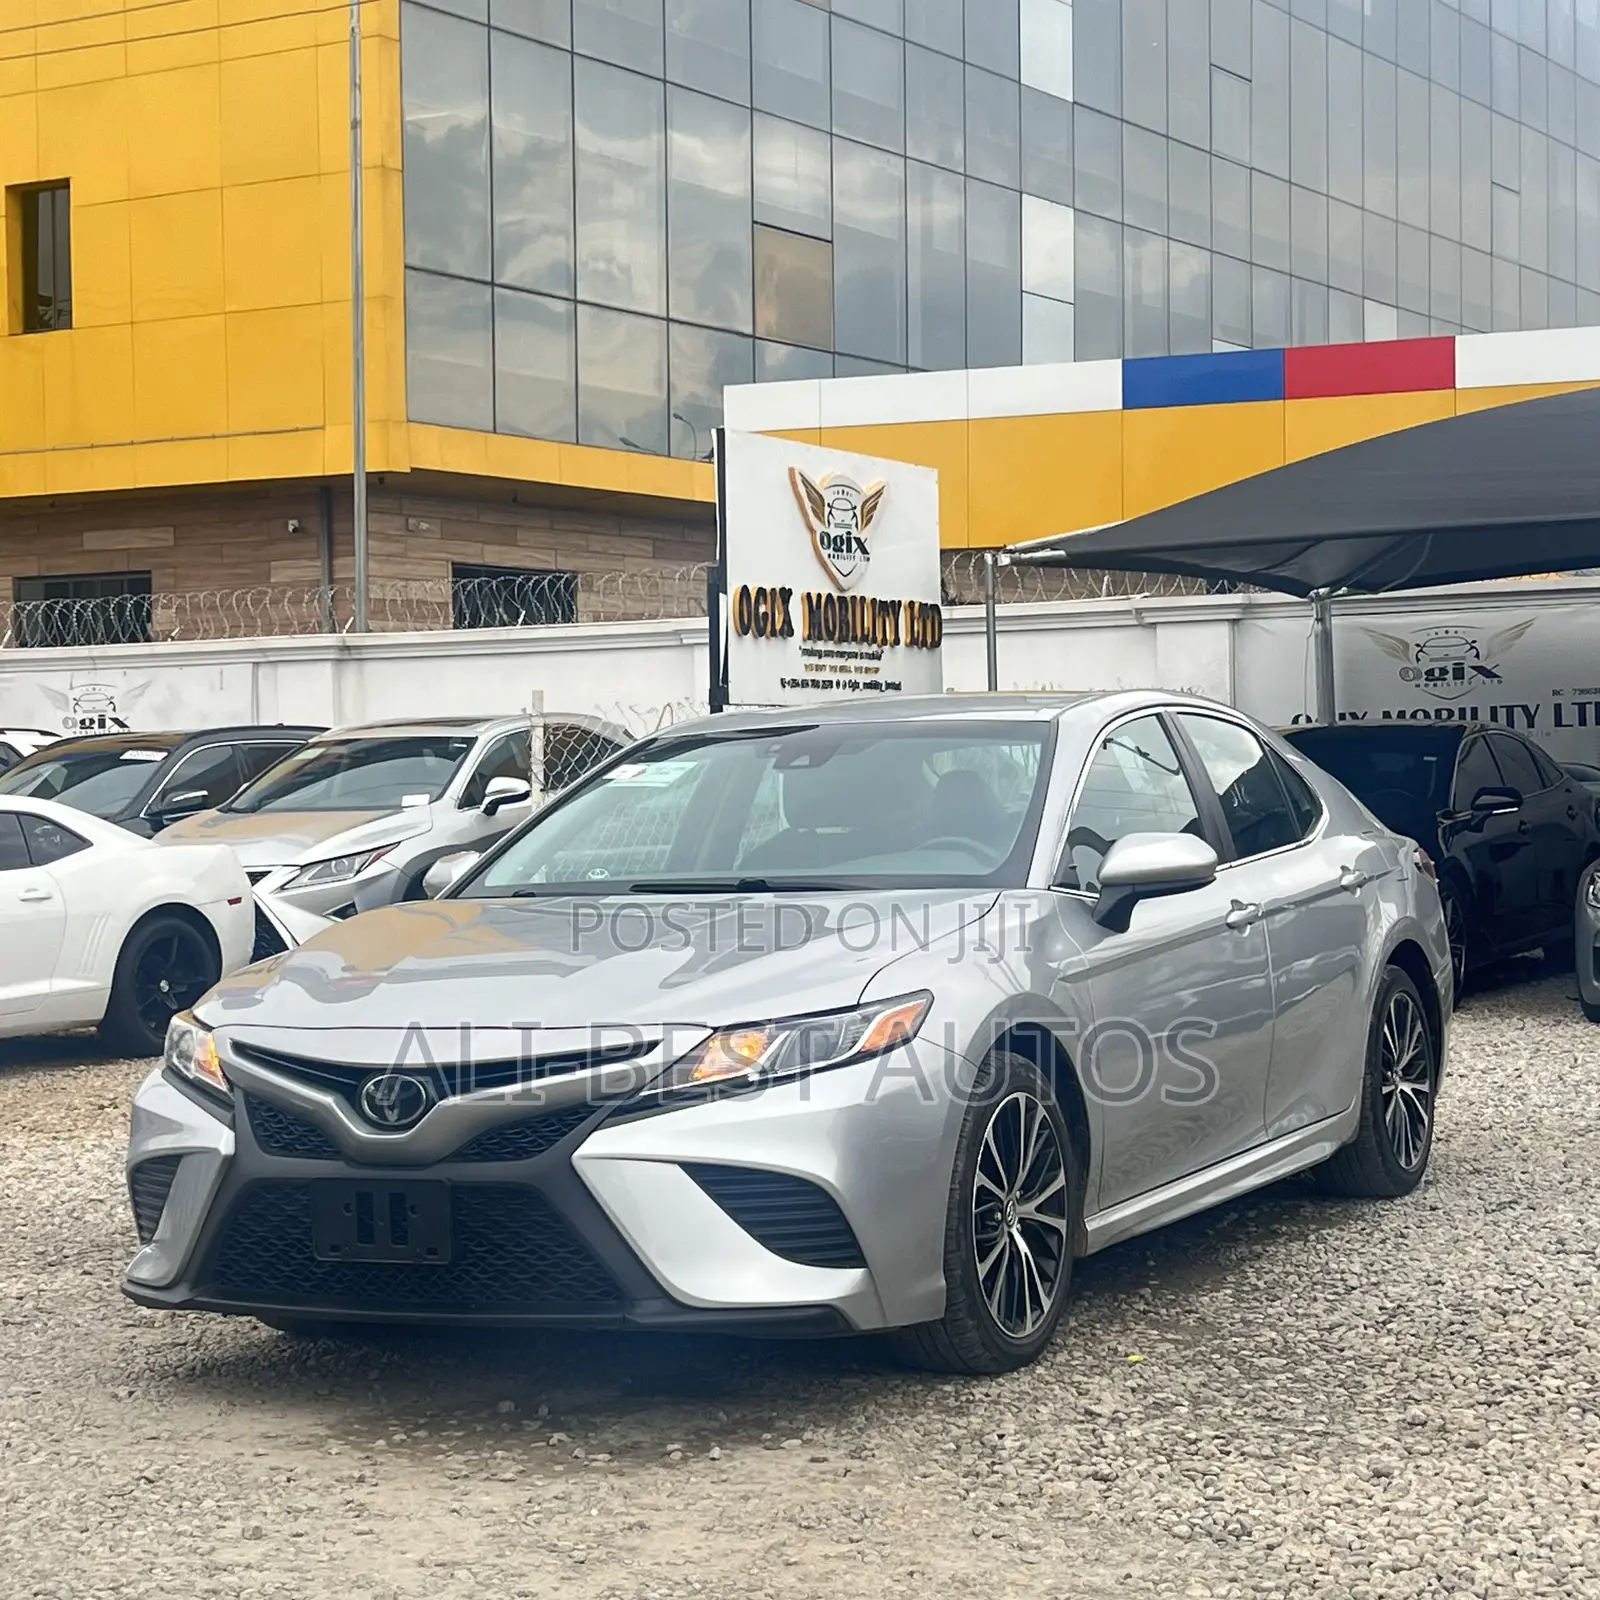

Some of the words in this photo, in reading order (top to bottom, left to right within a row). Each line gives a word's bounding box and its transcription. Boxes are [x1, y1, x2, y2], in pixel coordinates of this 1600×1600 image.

[820, 531, 870, 556] Ogix
[733, 584, 795, 638] OGIX
[801, 591, 902, 648] MOBILITY
[903, 599, 943, 649] LTD
[1399, 662, 1503, 682] Ogix
[1414, 680, 1473, 688] MOBILITY
[62, 714, 130, 730] Ogix
